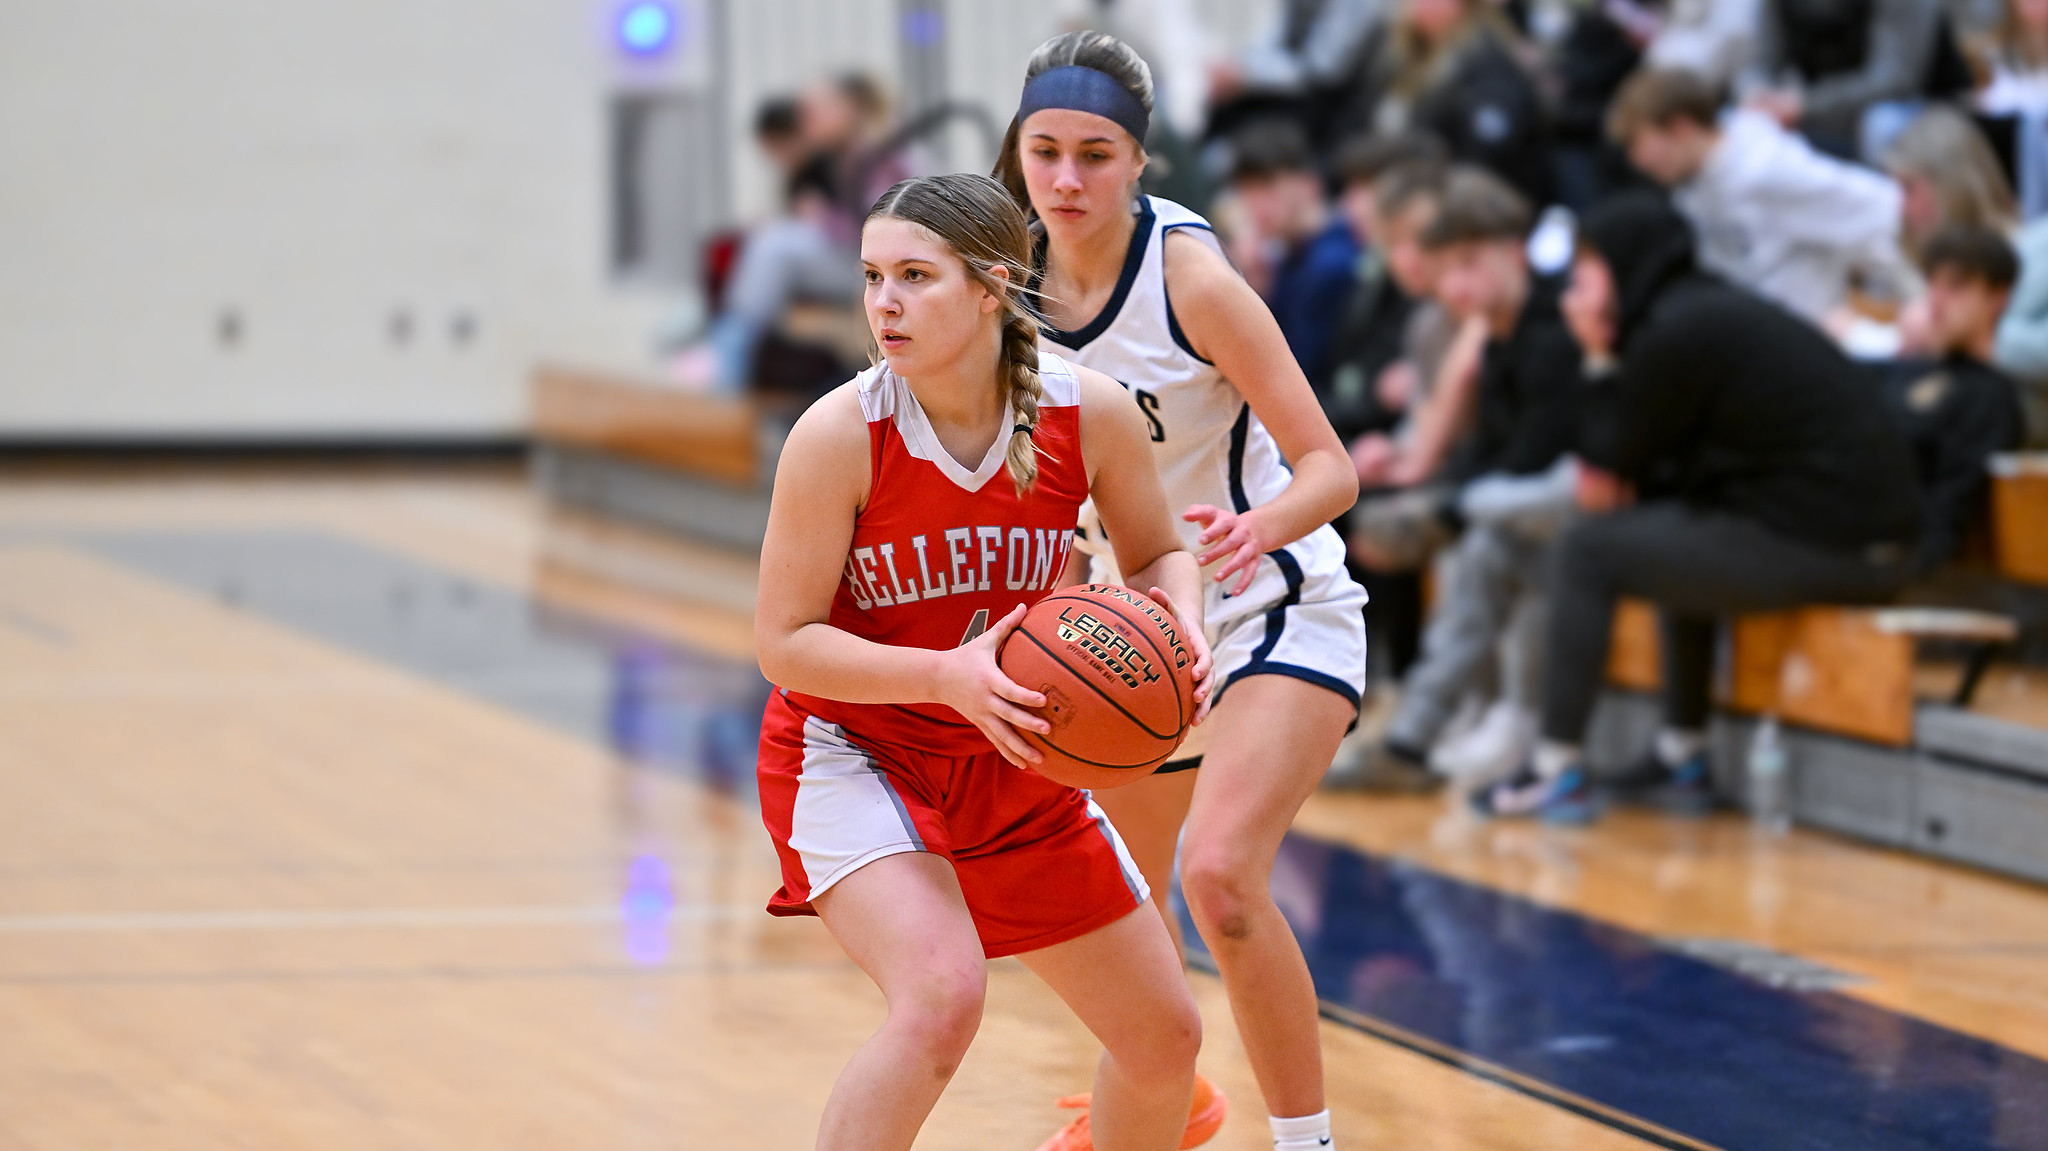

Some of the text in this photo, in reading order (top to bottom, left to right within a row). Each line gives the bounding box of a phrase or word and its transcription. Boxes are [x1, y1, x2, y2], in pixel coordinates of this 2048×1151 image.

[1056, 606, 1161, 684] LEGACY
[1077, 636, 1139, 689] 1000
[1080, 584, 1190, 669] SPALDING
